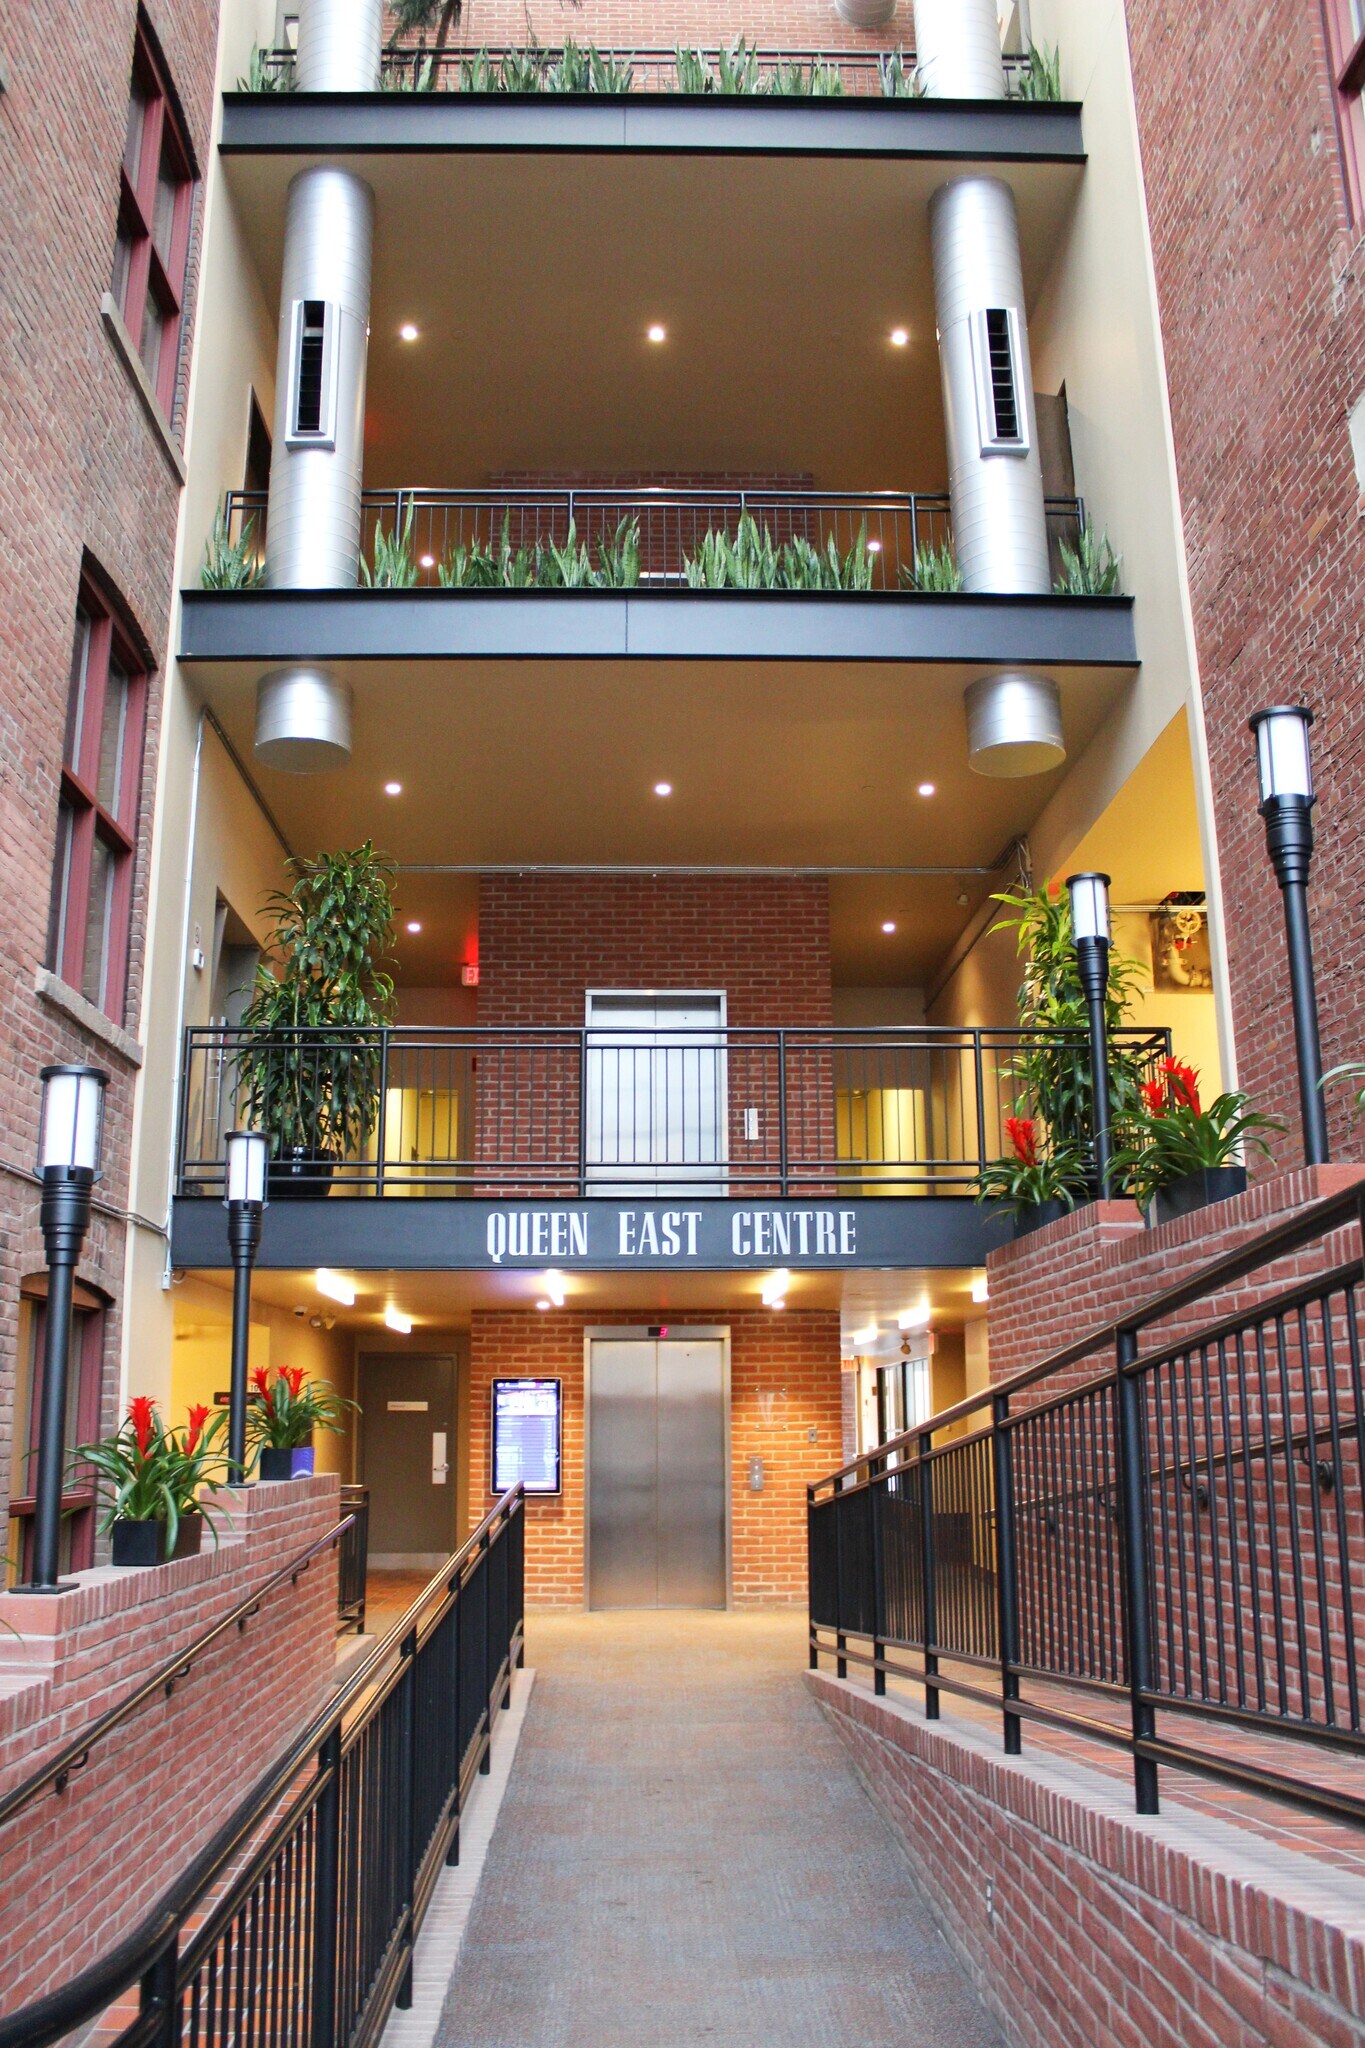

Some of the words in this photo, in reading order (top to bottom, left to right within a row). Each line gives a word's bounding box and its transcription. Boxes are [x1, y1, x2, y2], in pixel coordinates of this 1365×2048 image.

[486, 1212, 589, 1264] QUEEN
[618, 1211, 703, 1256] EAST
[732, 1211, 857, 1256] CENTRE
[660, 1326, 668, 1338] 3
